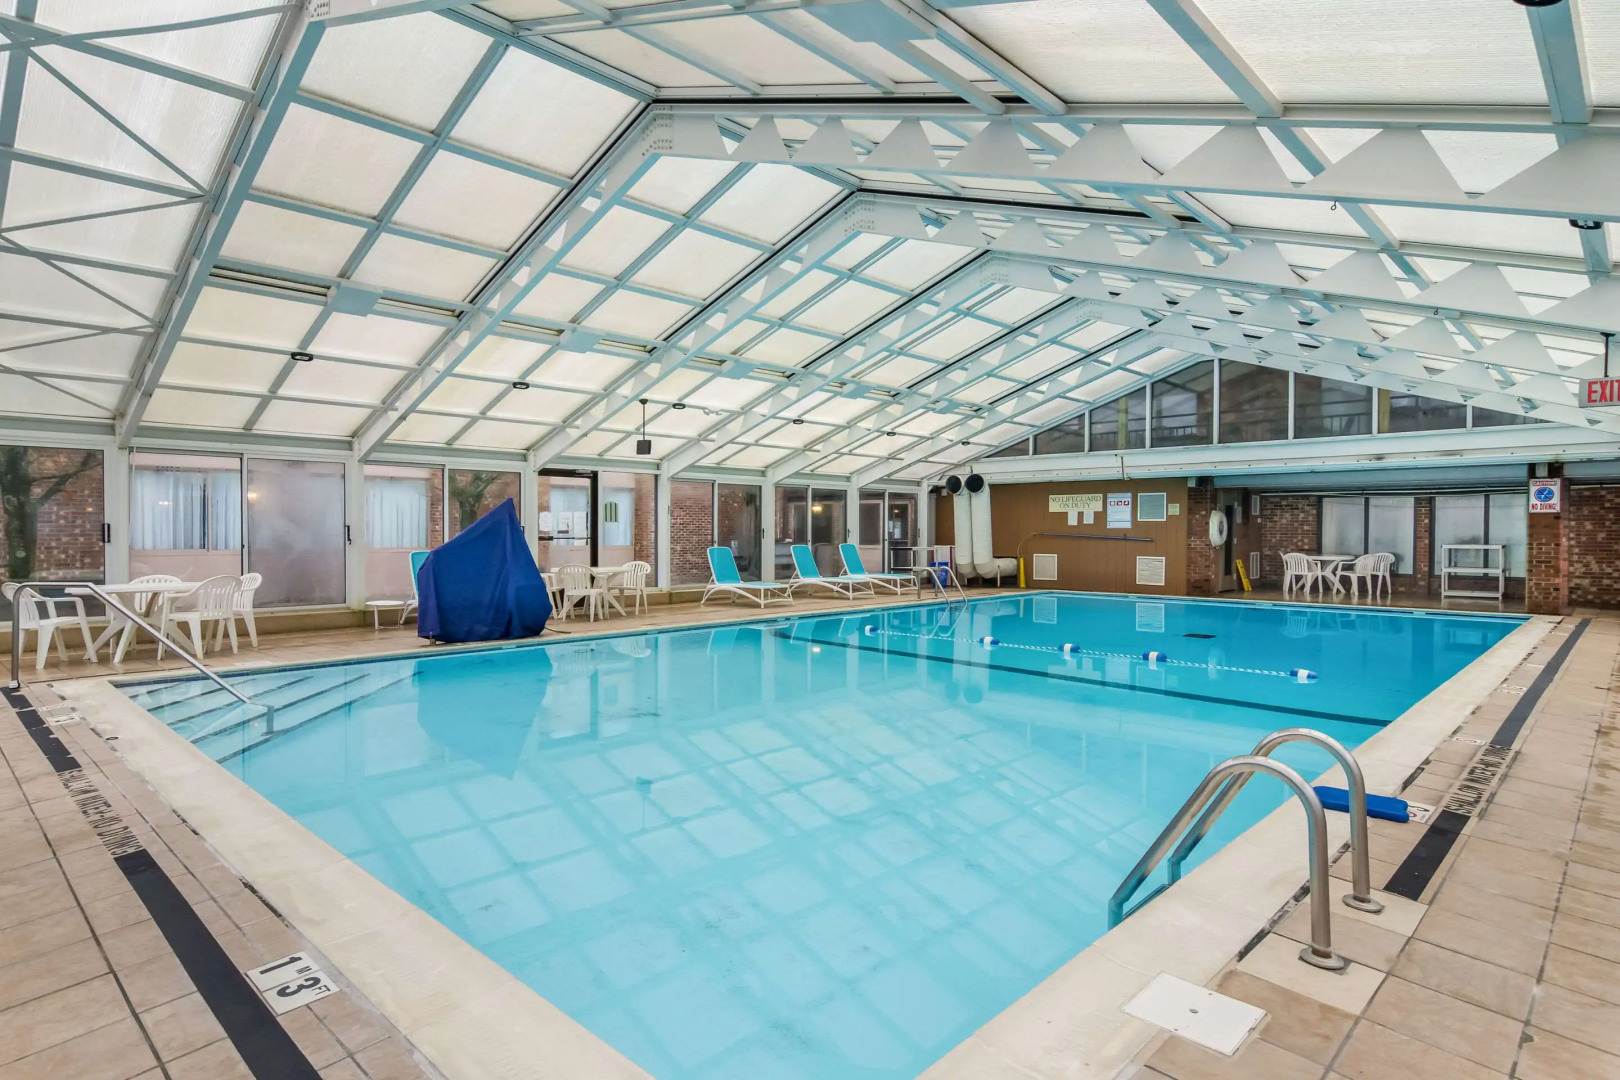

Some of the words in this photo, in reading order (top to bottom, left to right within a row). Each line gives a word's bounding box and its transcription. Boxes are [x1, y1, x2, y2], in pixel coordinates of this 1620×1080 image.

[1587, 380, 1620, 403] EXIT
[1443, 784, 1487, 815] SHALLOW
[96, 825, 145, 856] DIVING
